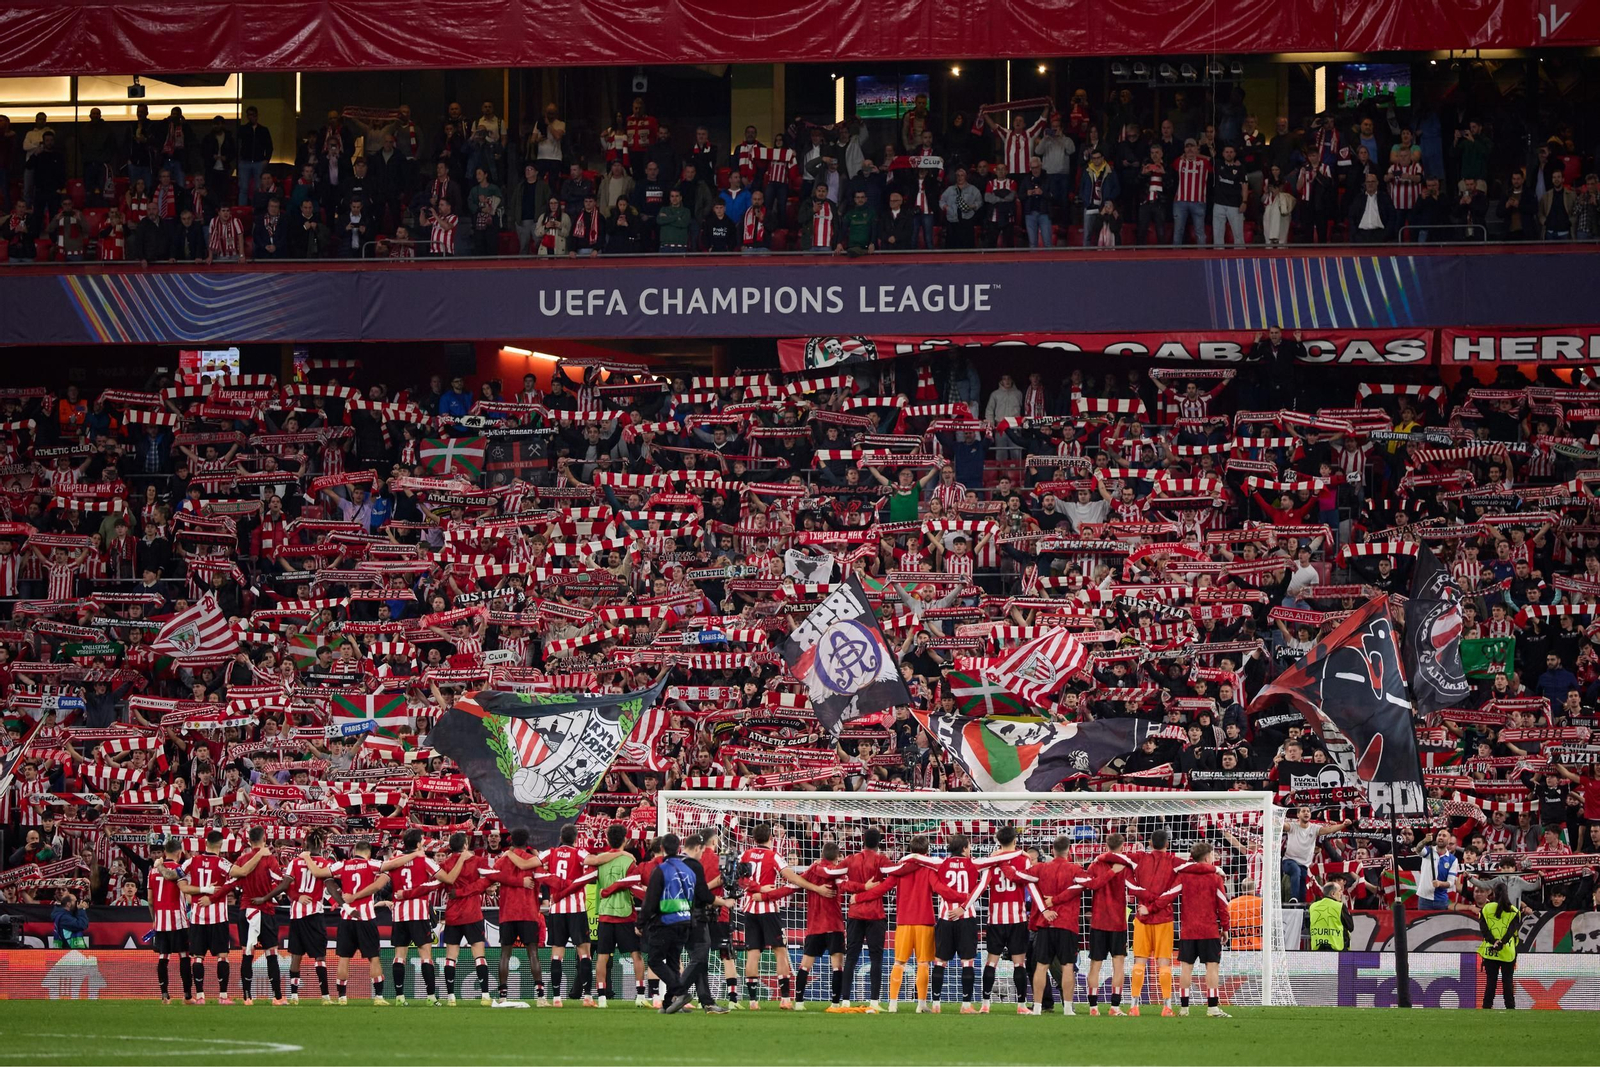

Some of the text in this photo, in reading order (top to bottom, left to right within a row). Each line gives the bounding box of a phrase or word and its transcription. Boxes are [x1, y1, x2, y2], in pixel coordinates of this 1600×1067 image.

[539, 288, 628, 316] UEFA
[639, 285, 844, 315] CHAMPIONS
[860, 284, 992, 312] LEAGUE
[34, 445, 89, 456] ATHLETIC CLUB
[502, 461, 533, 469] ALGORTA
[115, 483, 124, 493] 25
[428, 494, 486, 505] ATHLETIC CLUB
[867, 530, 876, 539] 25
[689, 569, 724, 579] ATHLETIC
[1119, 596, 1185, 618] JUSTIZIA
[1274, 610, 1294, 618] AUPA
[1041, 616, 1081, 625] ICHH
[488, 653, 508, 661] CLUB
[1487, 662, 1505, 673] bai
[345, 724, 362, 732] PARIS
[1520, 730, 1563, 739] ICHH
[748, 732, 808, 750] ATHLETIC CLUB
[737, 751, 794, 763] AUPA ATHLETIC
[1294, 792, 1333, 800] ATHLETIC
[110, 834, 146, 842] ATHLETIC
[557, 860, 568, 879] 6
[197, 866, 212, 889] 17
[301, 867, 317, 894] 10
[401, 868, 412, 891] 3
[945, 871, 967, 893] 20
[156, 876, 164, 902] 7
[351, 875, 361, 894] 2
